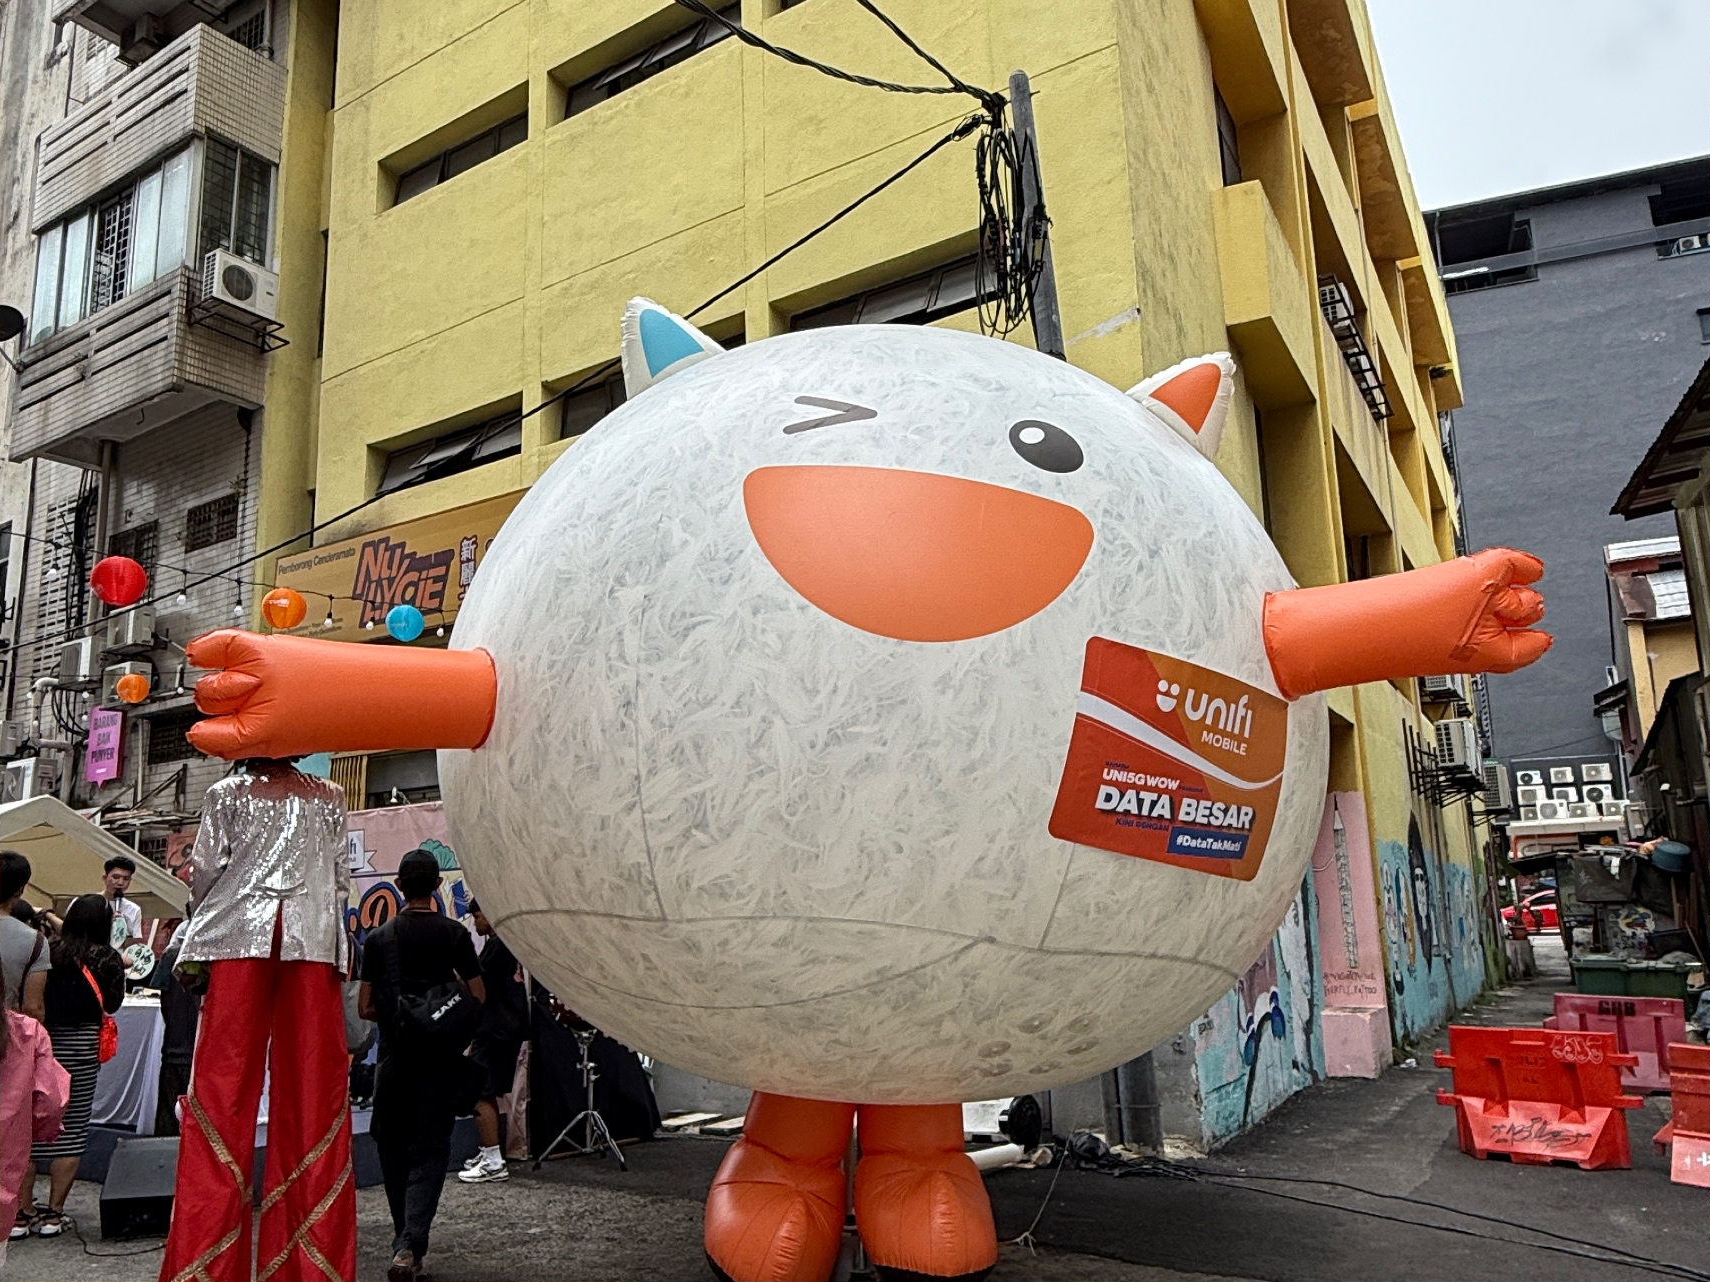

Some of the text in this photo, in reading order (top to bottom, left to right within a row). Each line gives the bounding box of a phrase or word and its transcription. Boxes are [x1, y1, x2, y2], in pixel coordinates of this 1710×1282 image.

[1184, 688, 1253, 738] unifi
[1201, 731, 1247, 755] MOBILE
[1095, 785, 1254, 829] DATA BESAR
[1176, 834, 1241, 852] #DataTakMati
